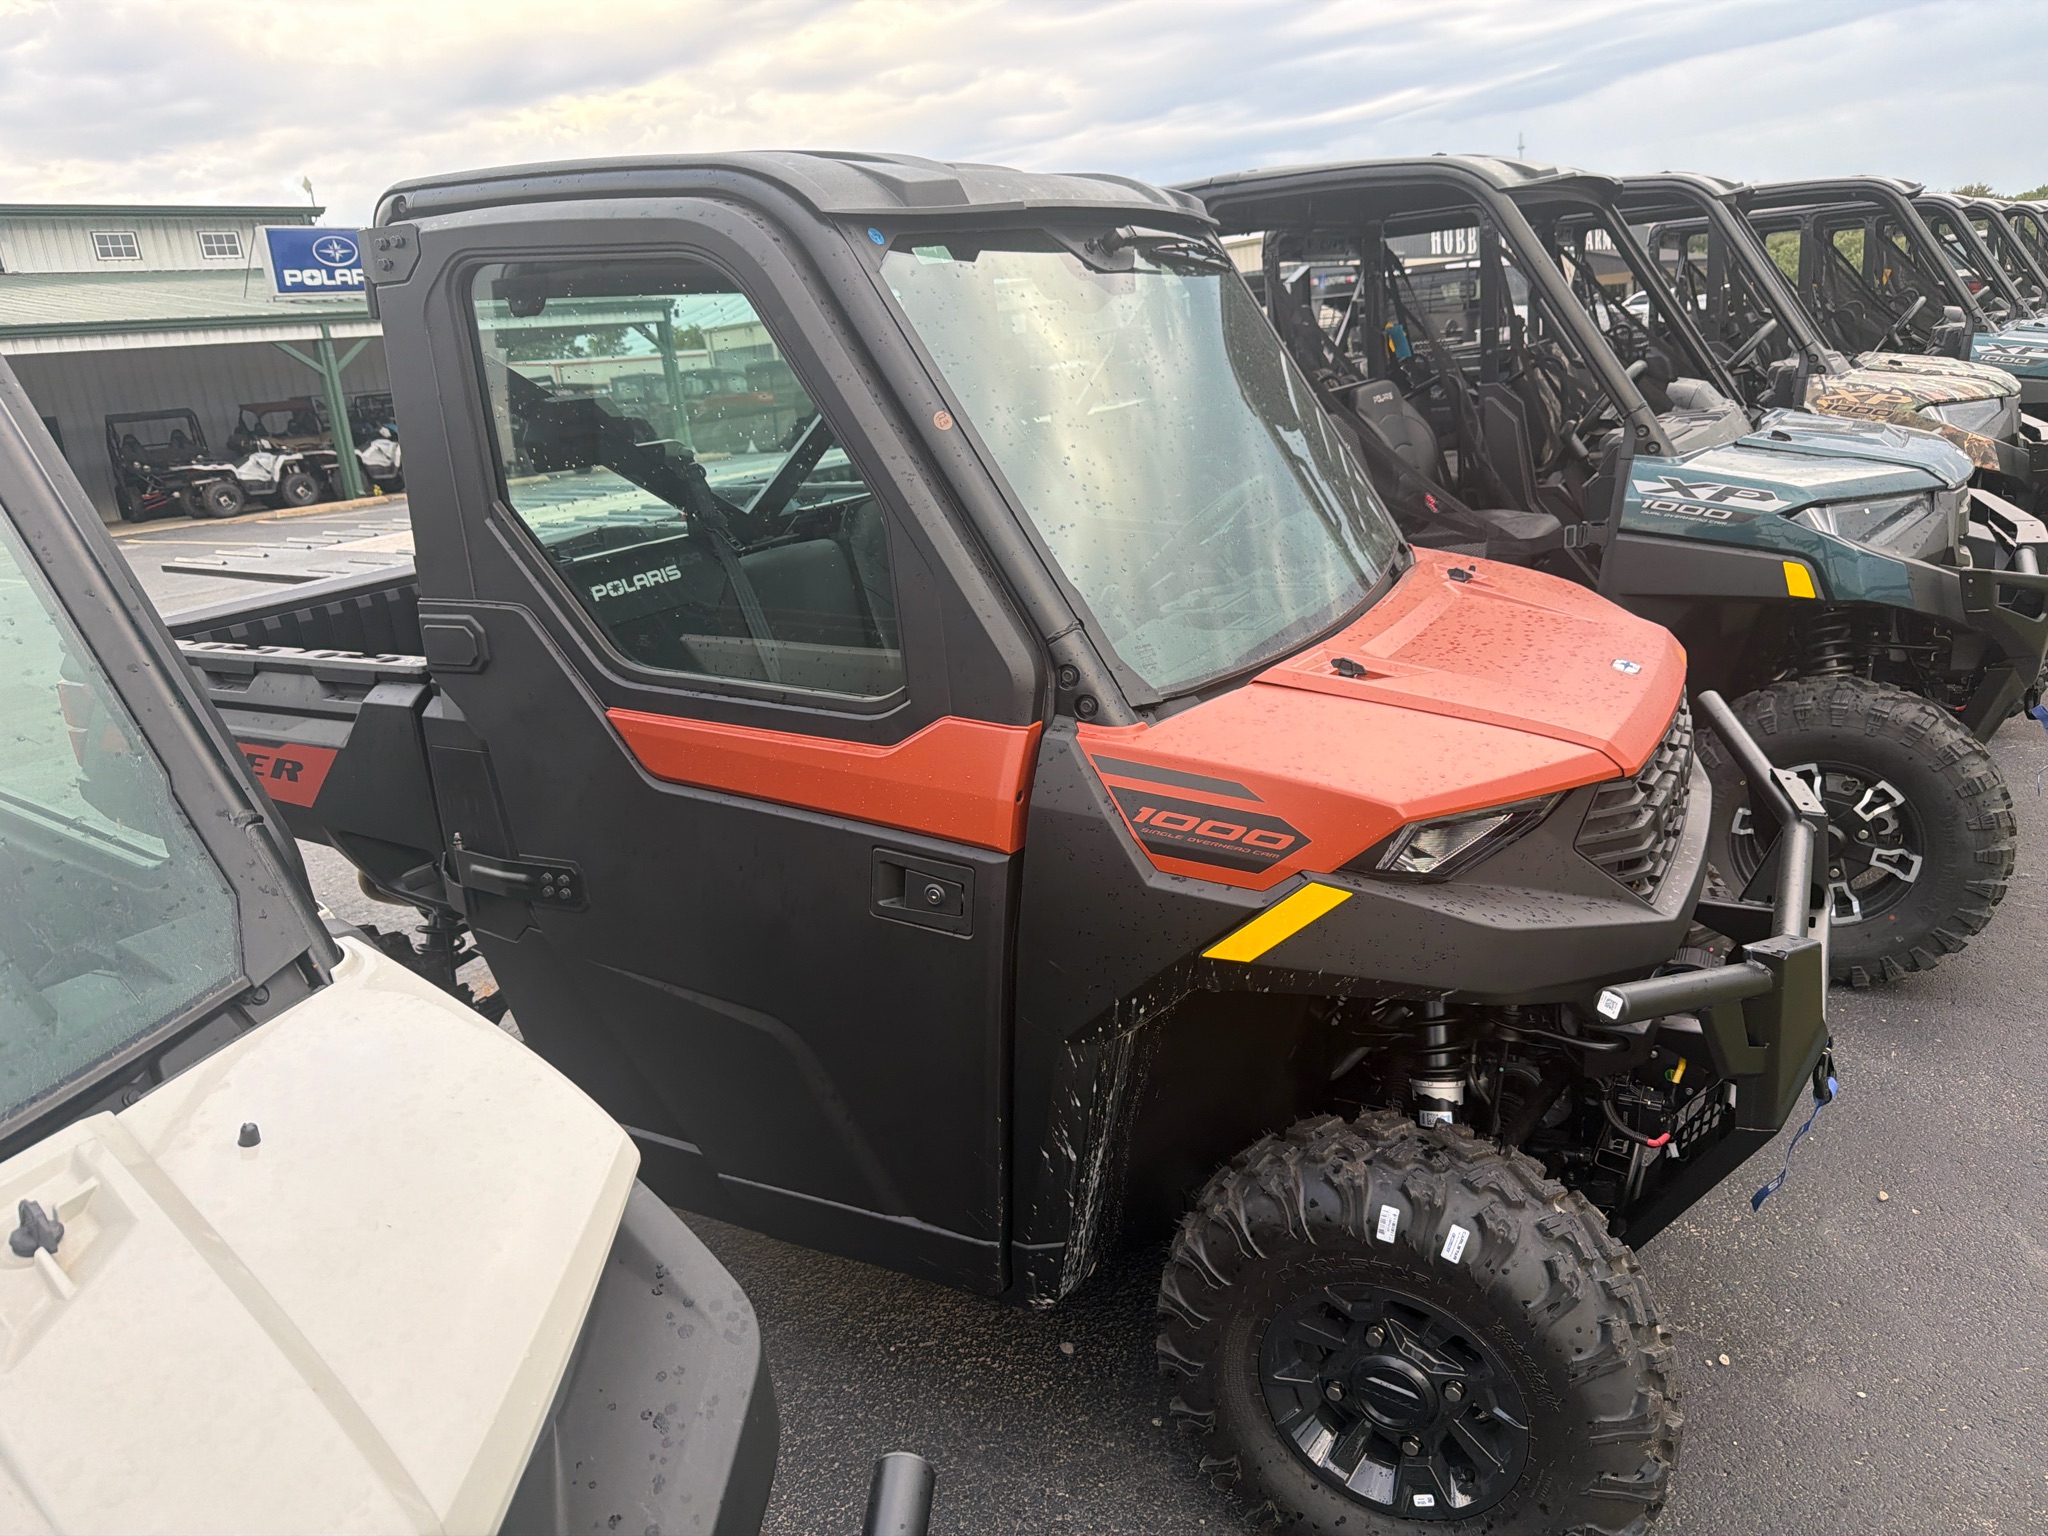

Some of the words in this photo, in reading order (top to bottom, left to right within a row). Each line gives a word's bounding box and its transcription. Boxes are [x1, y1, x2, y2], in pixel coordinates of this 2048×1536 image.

[1980, 354, 2030, 364] 1000
[1820, 388, 1913, 405] XP
[1825, 403, 1894, 417] 1000
[1643, 475, 1779, 503] XP
[1641, 499, 1733, 520] 1000
[590, 564, 682, 602] POLARIS
[1132, 806, 1296, 851] 1000
[1141, 827, 1184, 841] SINGLE
[1187, 837, 1251, 854] OVERHEAD
[1252, 850, 1280, 859] CAM
